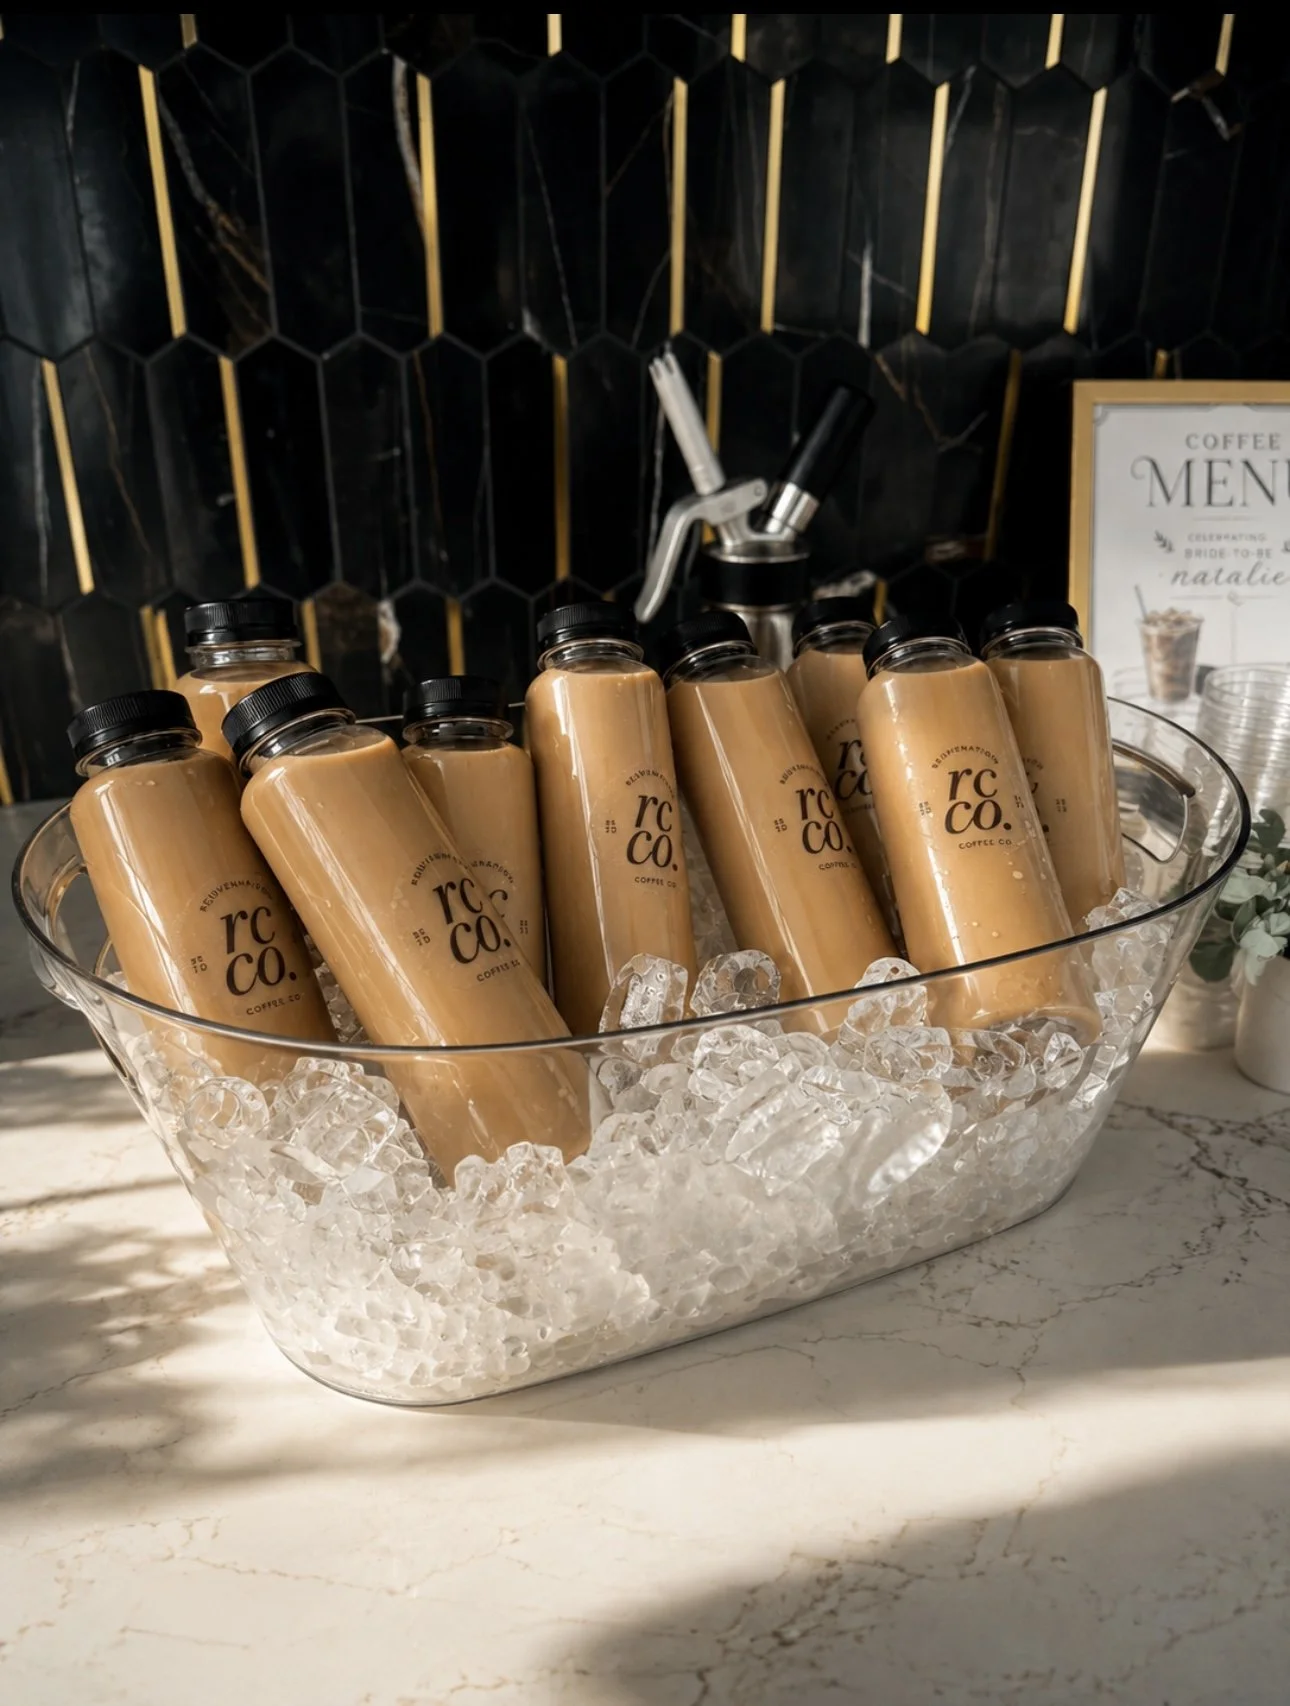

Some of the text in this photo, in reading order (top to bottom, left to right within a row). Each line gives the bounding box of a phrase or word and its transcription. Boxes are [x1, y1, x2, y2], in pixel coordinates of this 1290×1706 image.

[1185, 432, 1281, 451] COFFEE
[1130, 455, 1290, 508] MEN
[1187, 532, 1267, 543] CELEBRATING
[1170, 560, 1290, 587] natalie
[948, 768, 998, 801] rc
[635, 795, 673, 832] rc
[795, 788, 834, 821] rc
[944, 799, 1012, 835] co.
[626, 830, 678, 871] co.
[433, 877, 483, 925] rc
[220, 906, 276, 954] rc
[450, 915, 512, 964] co.
[226, 946, 297, 996] co.
